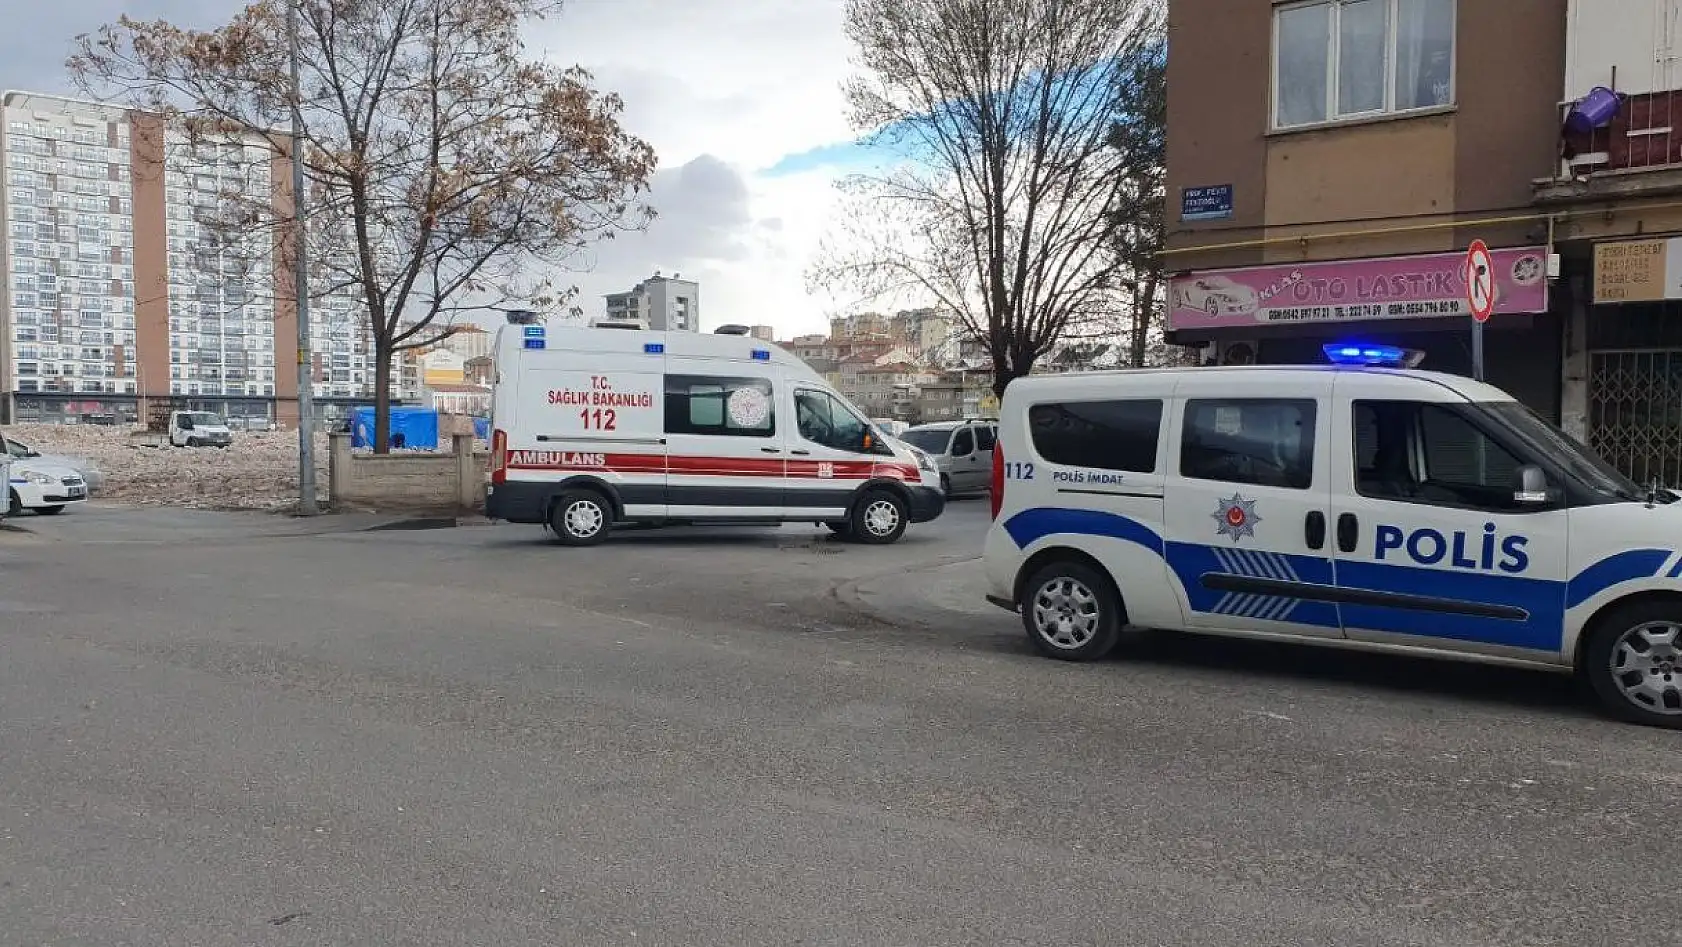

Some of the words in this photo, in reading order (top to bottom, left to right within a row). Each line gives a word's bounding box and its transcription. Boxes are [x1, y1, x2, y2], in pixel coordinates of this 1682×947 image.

[1293, 278, 1347, 301] OTO
[590, 376, 612, 390] T.C.
[548, 388, 589, 405] SAĞLIK
[592, 391, 653, 407] BAKANLIĞI
[580, 408, 616, 430] 112
[509, 450, 606, 466] AMBULANS
[1004, 462, 1034, 480] 112
